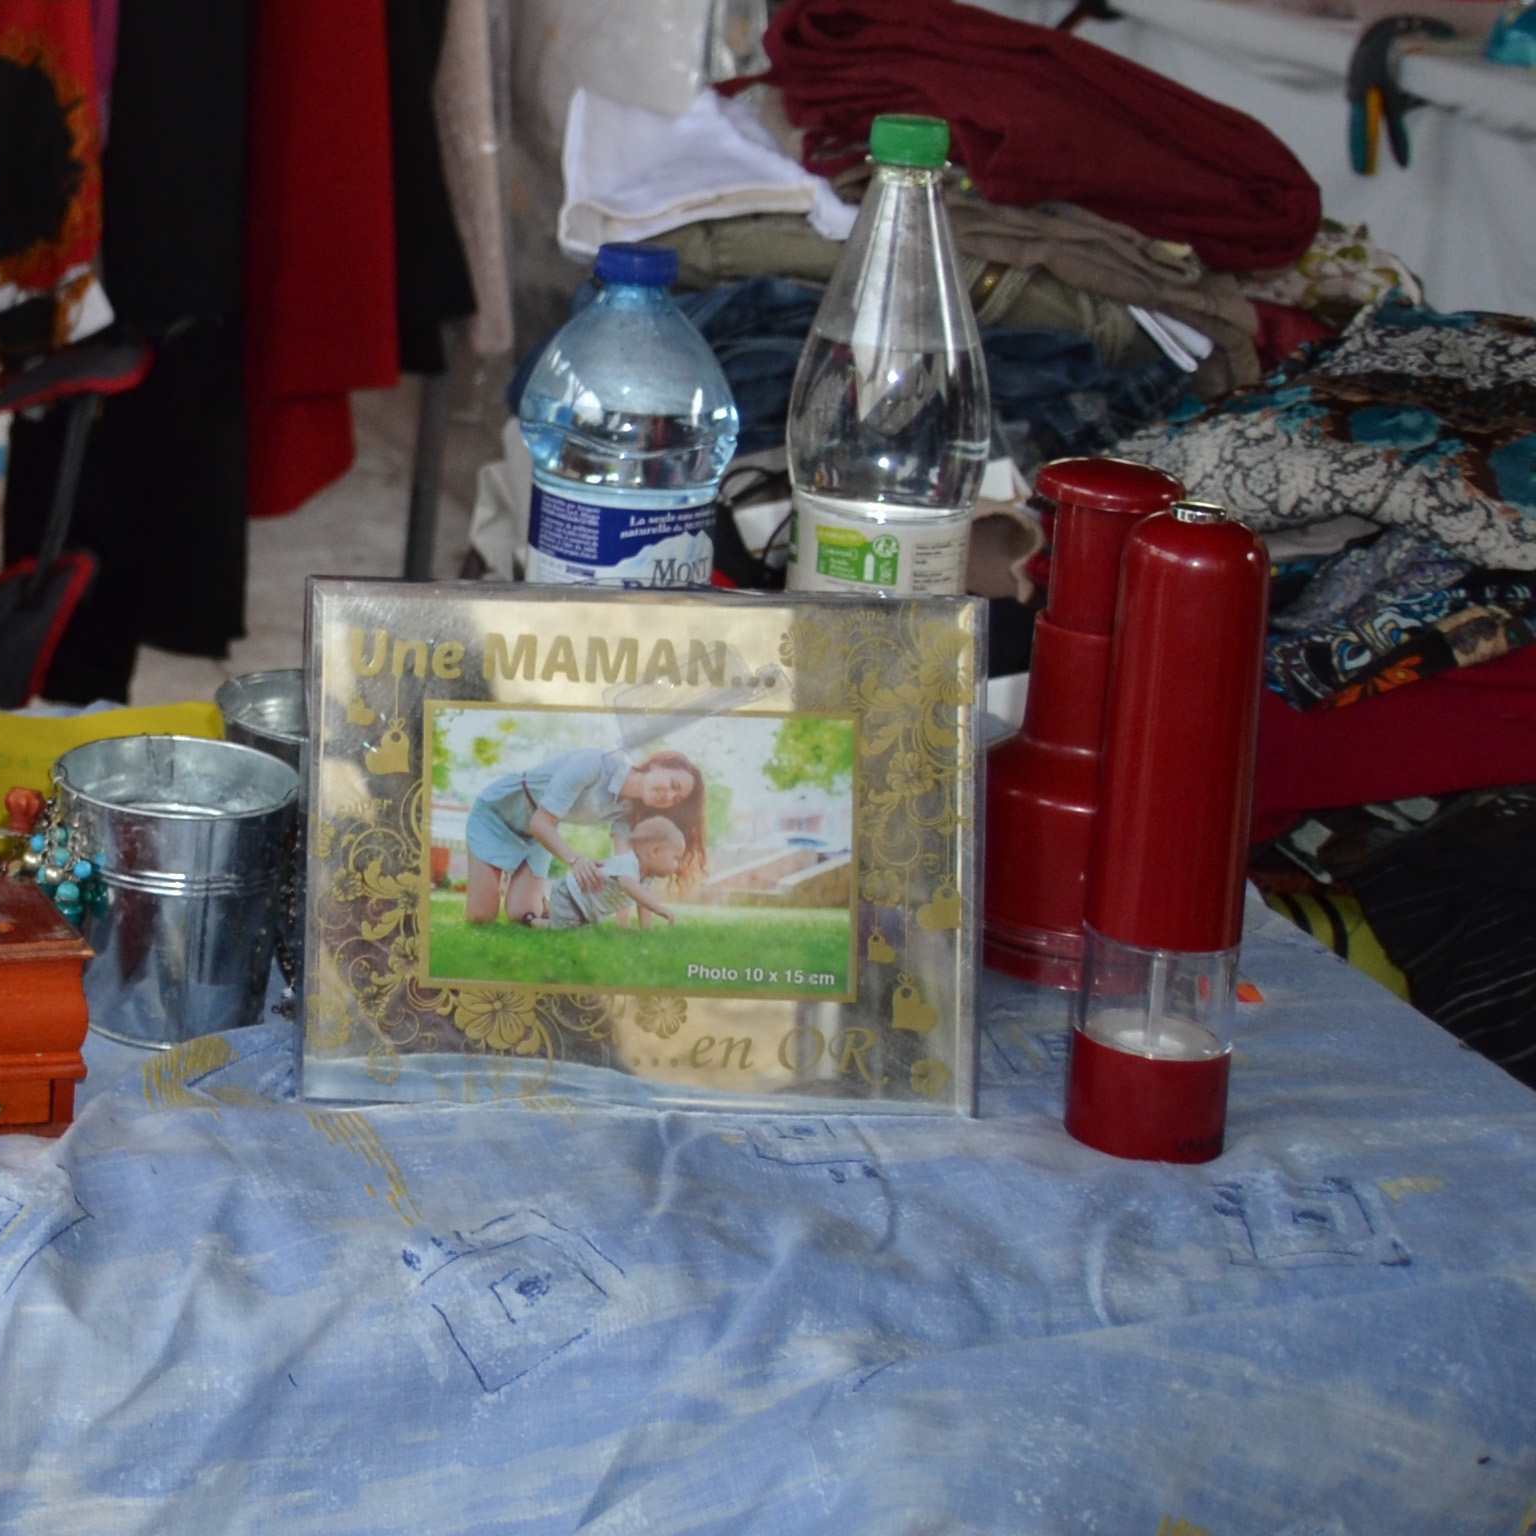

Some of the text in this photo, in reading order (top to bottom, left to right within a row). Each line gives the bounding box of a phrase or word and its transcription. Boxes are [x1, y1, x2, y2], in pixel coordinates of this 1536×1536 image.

[350, 627, 778, 688] Une MAMAN...
[686, 961, 836, 986] Photo 10 x 15 cm
[778, 1025, 890, 1087] OR
